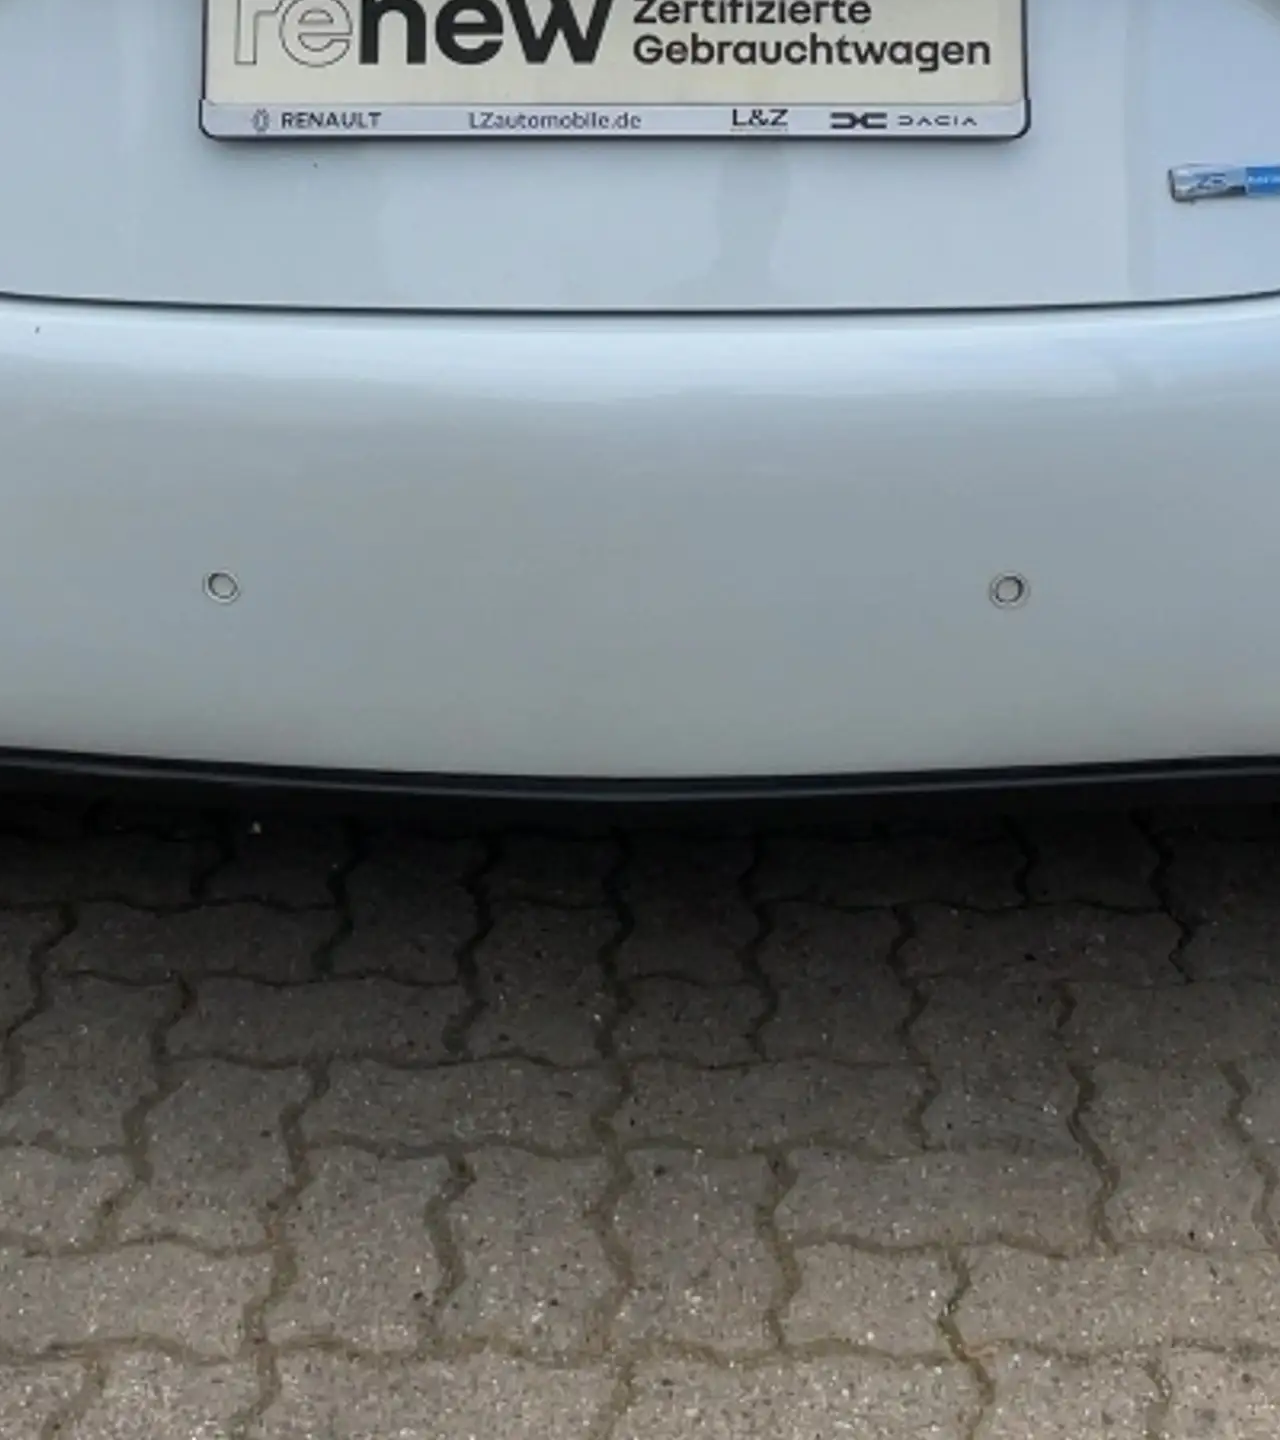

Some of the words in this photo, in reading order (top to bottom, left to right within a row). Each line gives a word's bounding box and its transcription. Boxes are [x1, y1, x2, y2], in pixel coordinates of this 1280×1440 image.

[632, 32, 992, 73] Gebrauchtwagen
[281, 111, 382, 129] RENAULT
[468, 111, 642, 130] LZautomobile.de
[731, 108, 789, 127] L&Z
